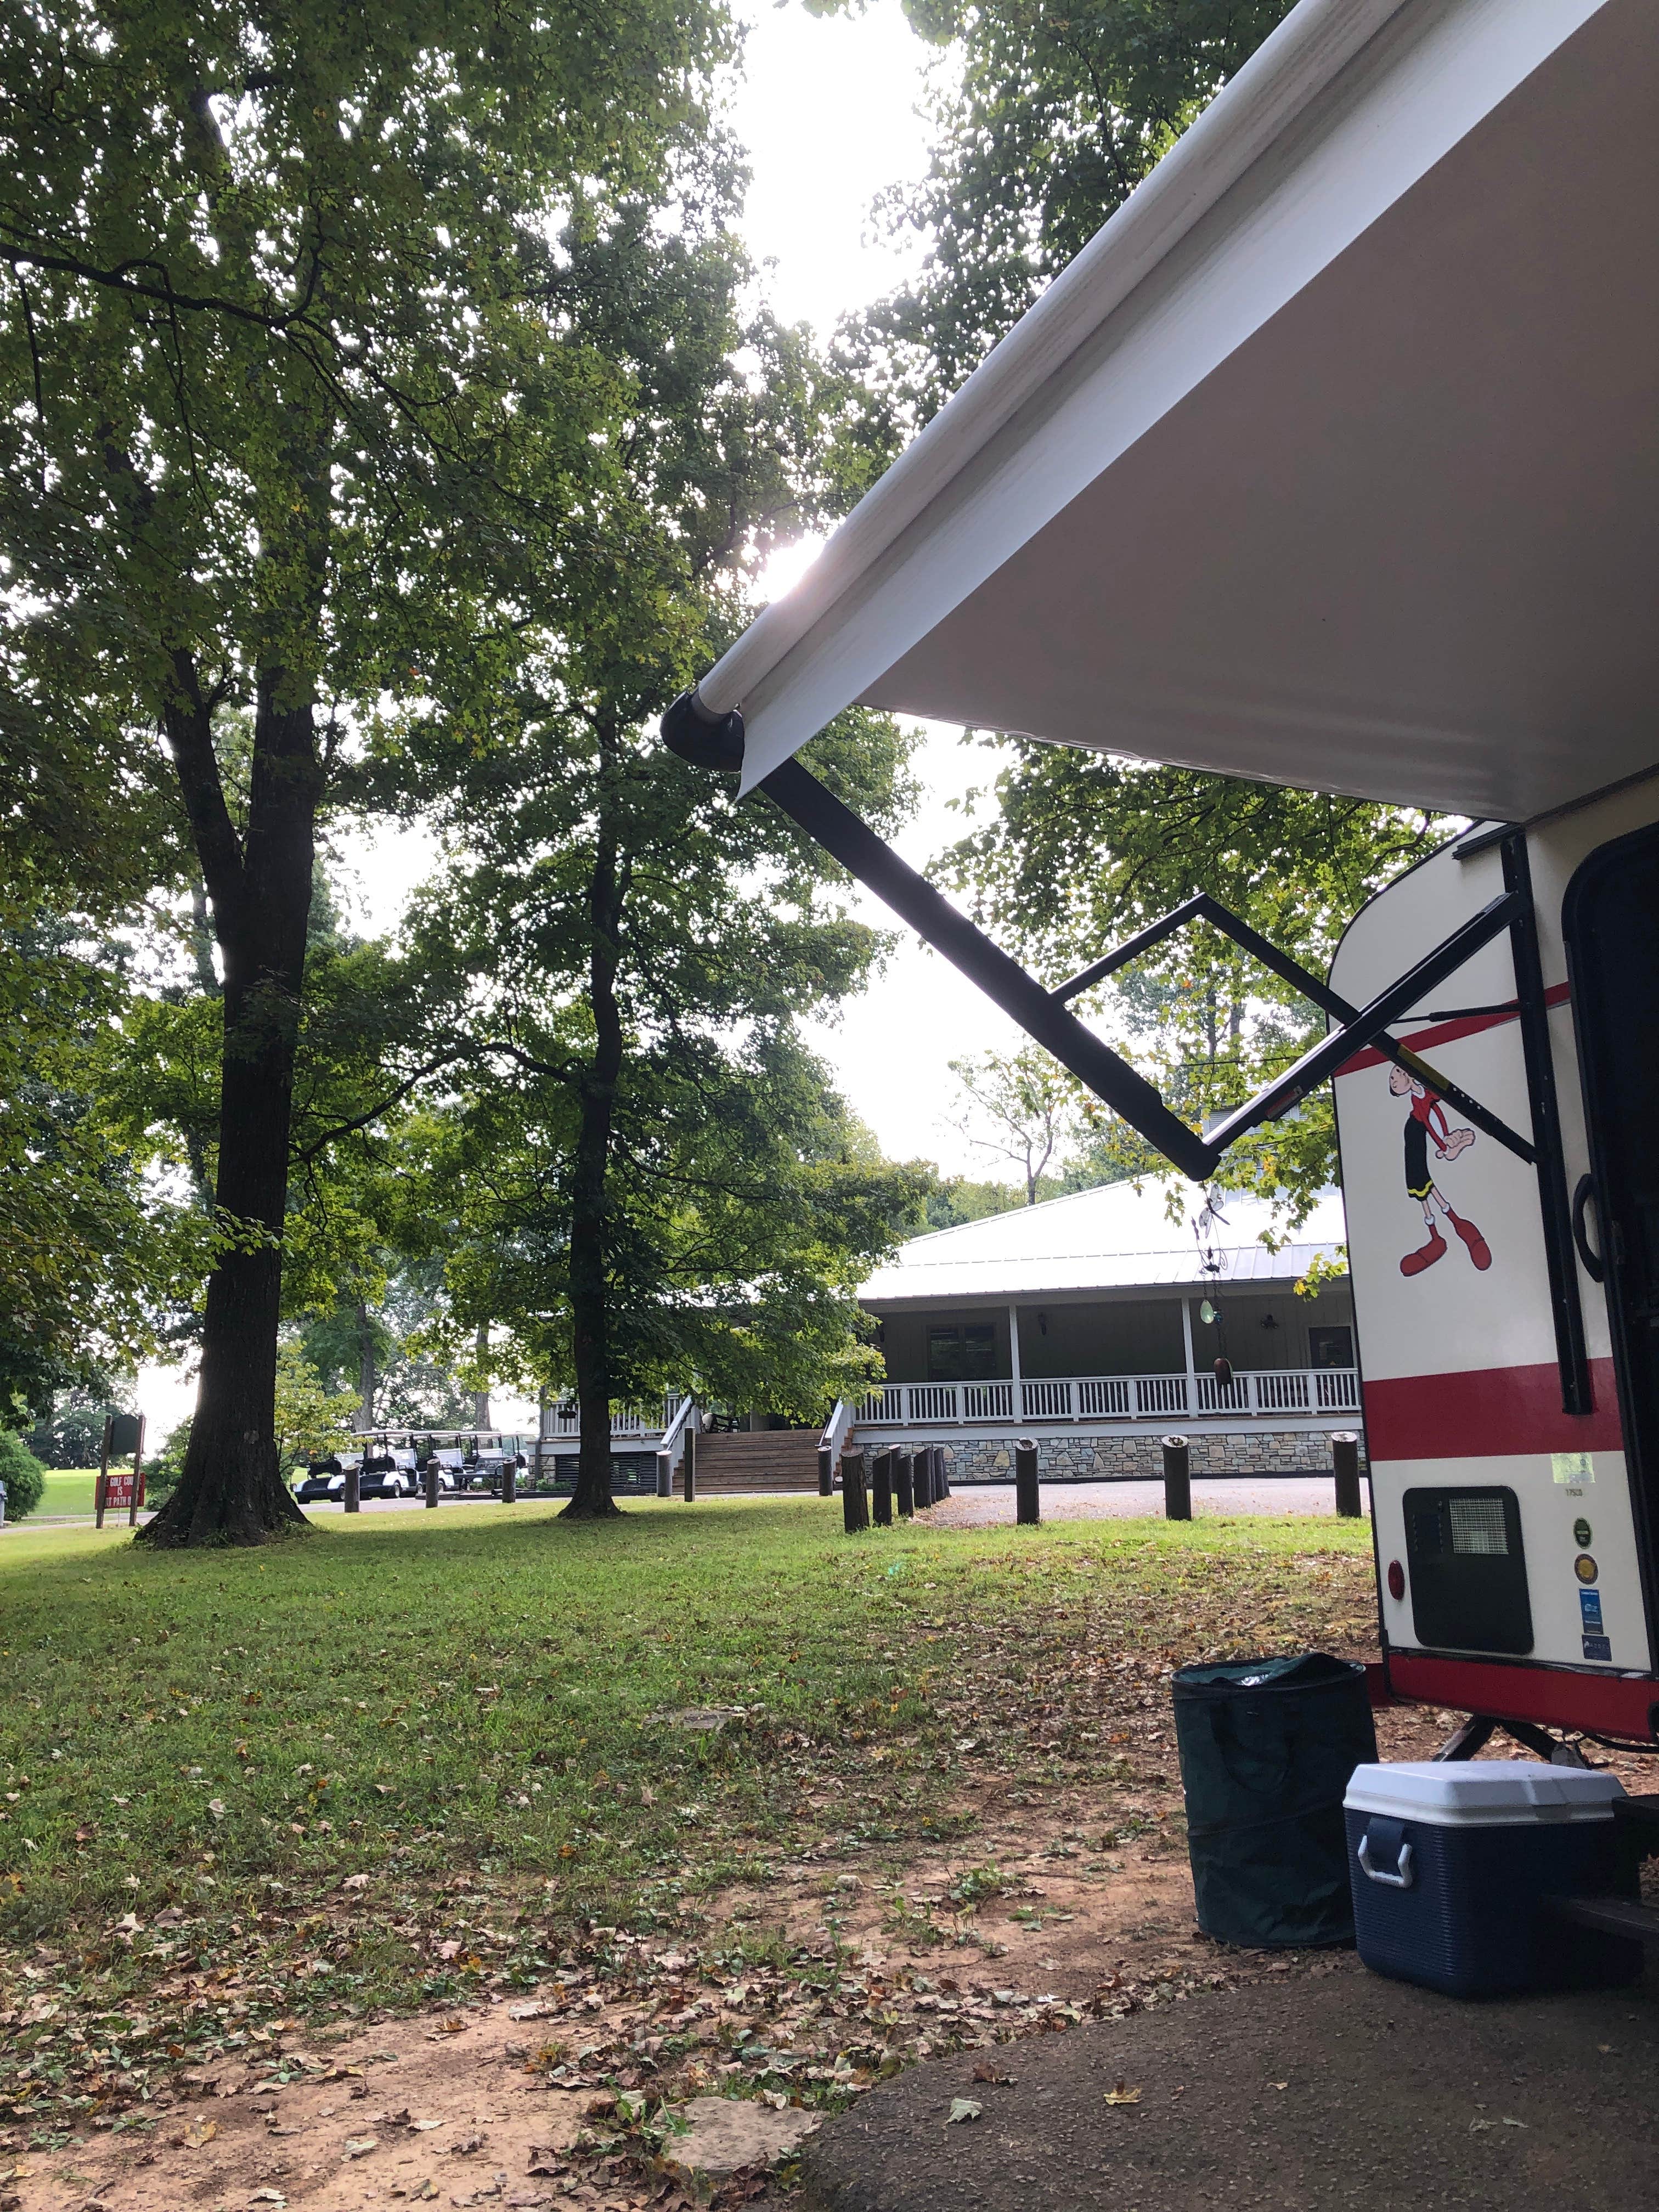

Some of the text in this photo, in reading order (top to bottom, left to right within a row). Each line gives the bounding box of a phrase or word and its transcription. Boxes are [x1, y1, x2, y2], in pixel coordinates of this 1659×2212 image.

[110, 1477, 122, 1487] GOLF
[117, 1486, 123, 1496] IS
[113, 1496, 126, 1506] PATH
